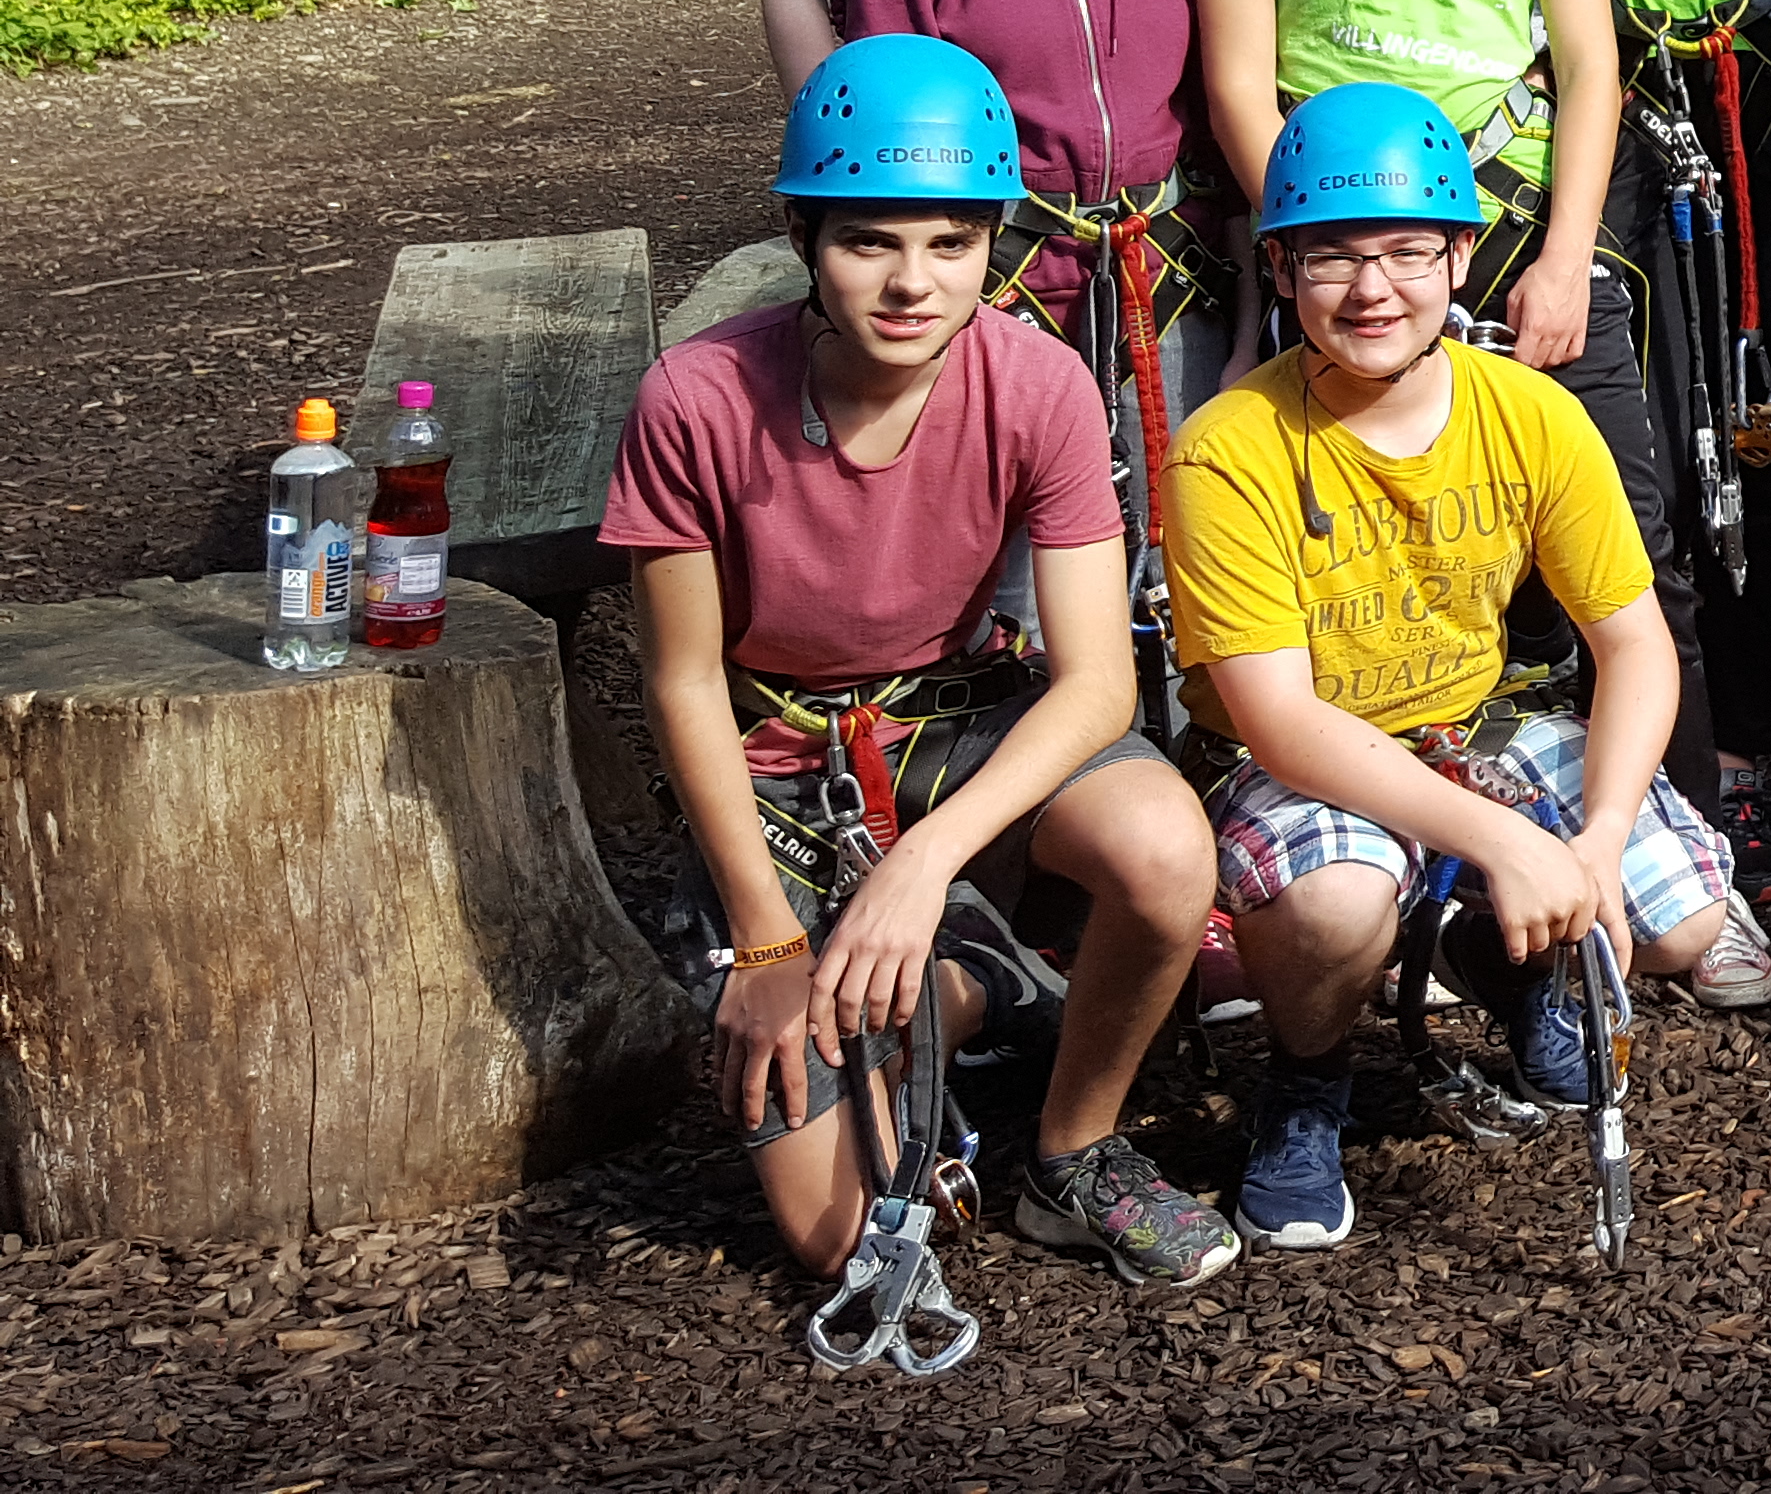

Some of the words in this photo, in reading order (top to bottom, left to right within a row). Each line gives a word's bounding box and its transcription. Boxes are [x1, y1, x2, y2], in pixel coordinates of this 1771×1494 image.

[876, 148, 973, 164] EDELRID
[1319, 173, 1407, 190] EDELRID
[325, 557, 349, 613] ACTIVE
[1388, 555, 1467, 582] MSTER
[310, 570, 325, 617] orange
[1309, 591, 1385, 635] IMITED
